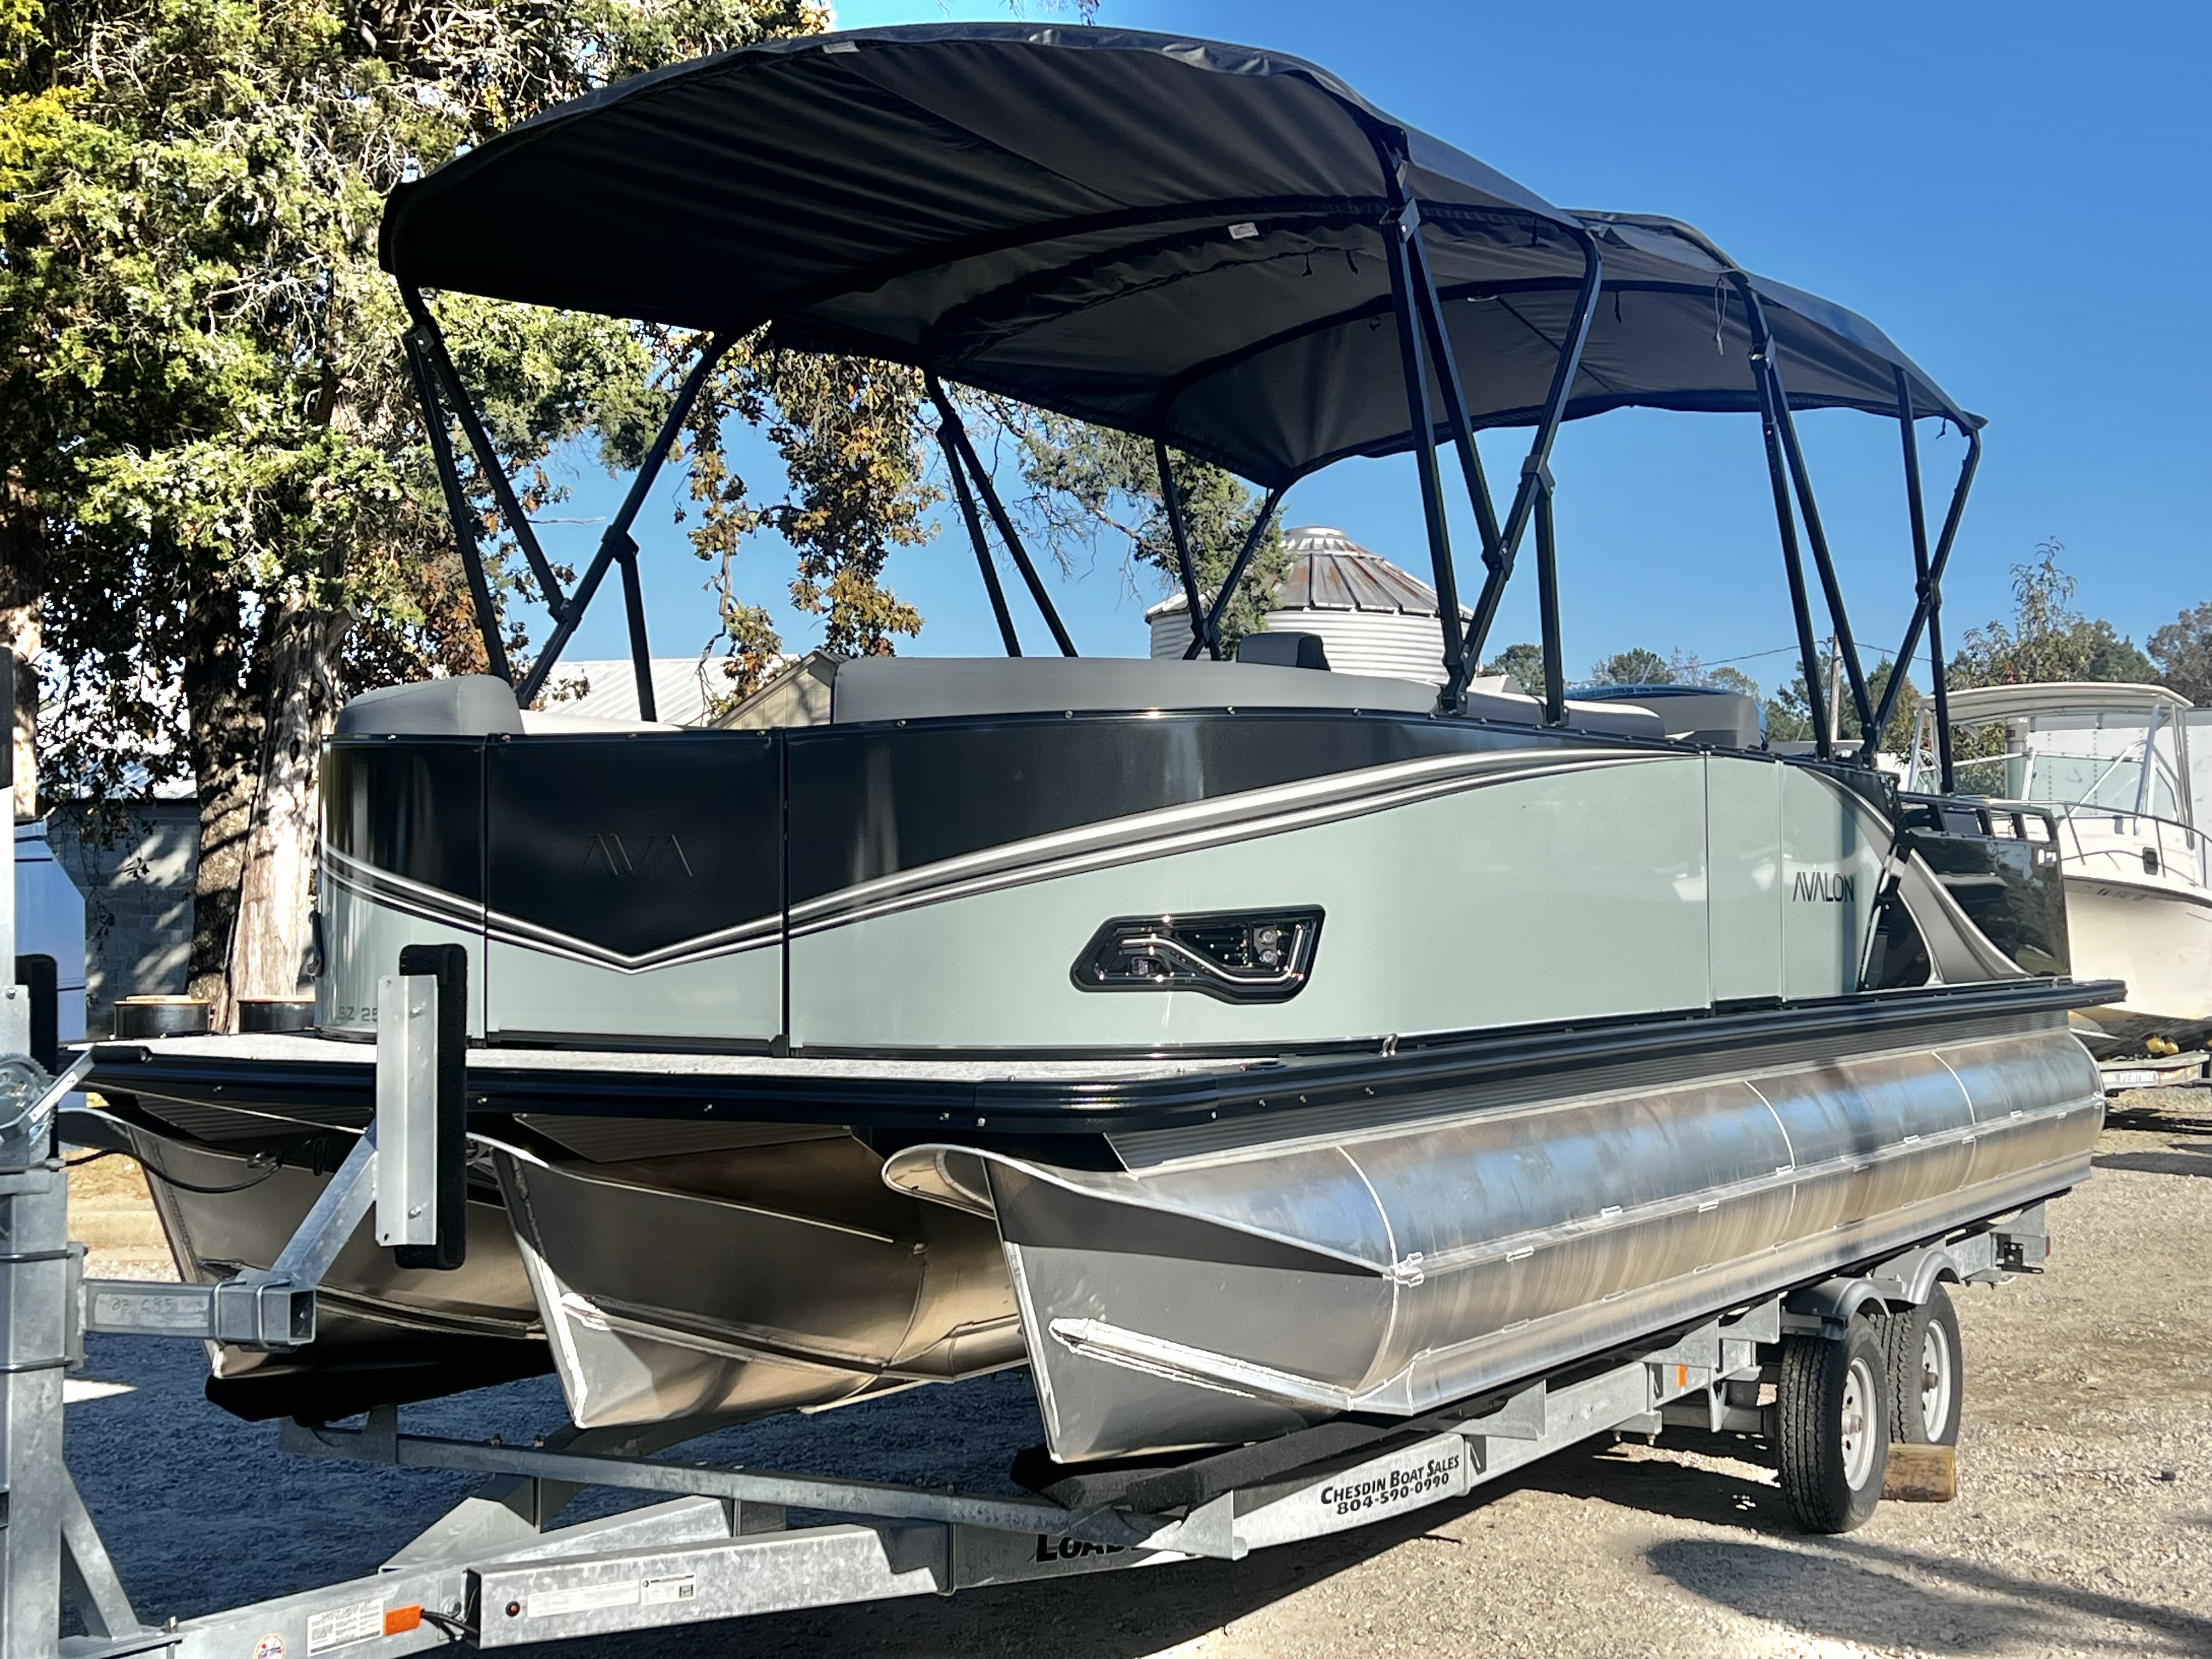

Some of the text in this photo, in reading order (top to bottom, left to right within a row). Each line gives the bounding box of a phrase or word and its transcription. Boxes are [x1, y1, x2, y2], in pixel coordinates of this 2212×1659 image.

[1792, 871, 1854, 903] AVALON
[1321, 1454, 1459, 1505] CHESDIN BOAT SALES
[1336, 1472, 1450, 1515] 804-590-0990
